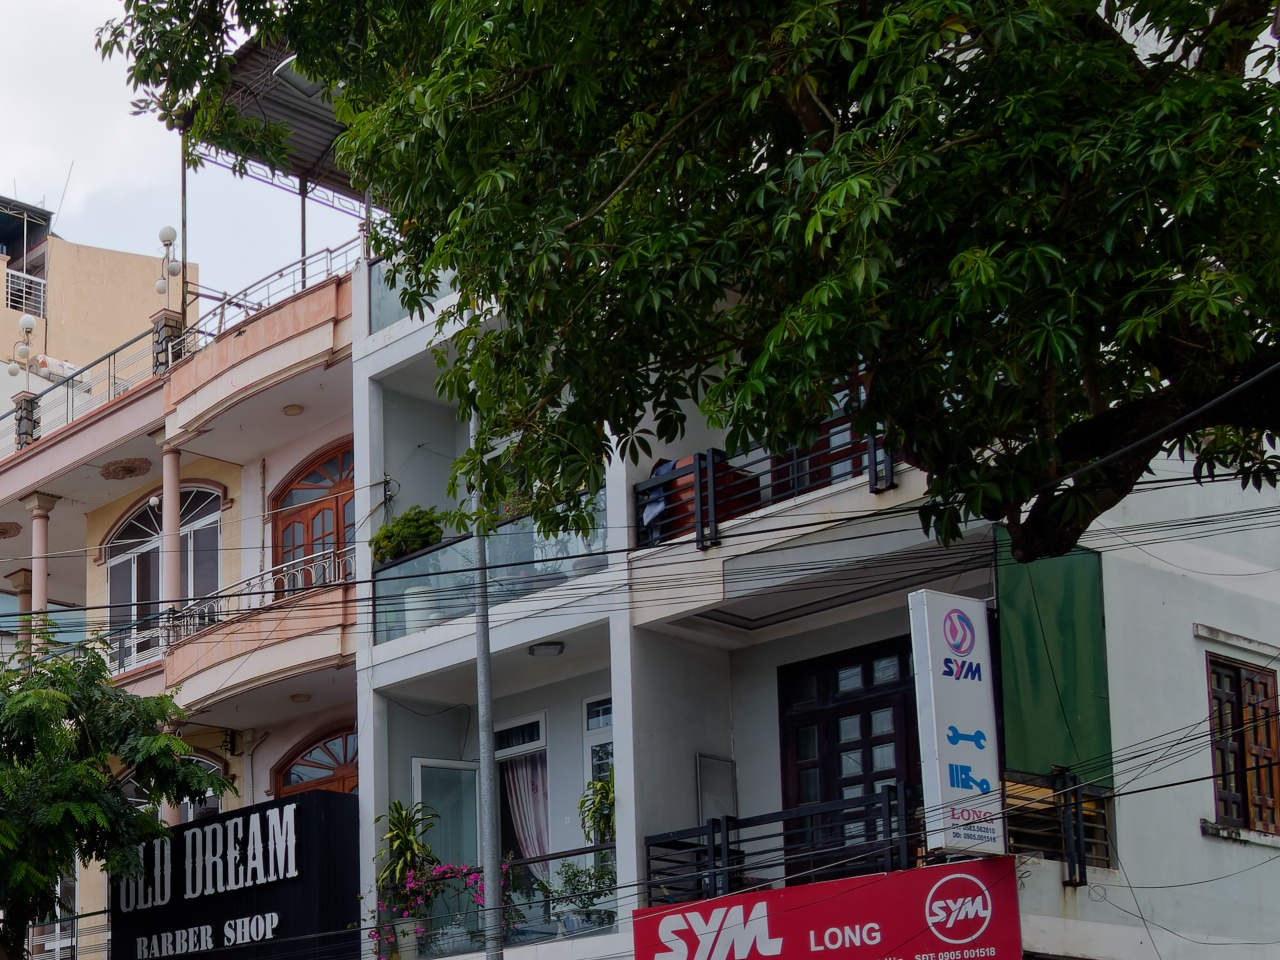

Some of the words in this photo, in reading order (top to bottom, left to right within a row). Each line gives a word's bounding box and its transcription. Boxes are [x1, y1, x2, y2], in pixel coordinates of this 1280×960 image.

[942, 658, 982, 682] SYM
[951, 808, 994, 824] LONG
[184, 803, 298, 900] DREAM
[928, 896, 989, 929] SYM
[136, 924, 214, 960] BARBER
[223, 912, 279, 947] SHOP
[810, 922, 881, 952] LONG
[964, 947, 996, 960] 001518
